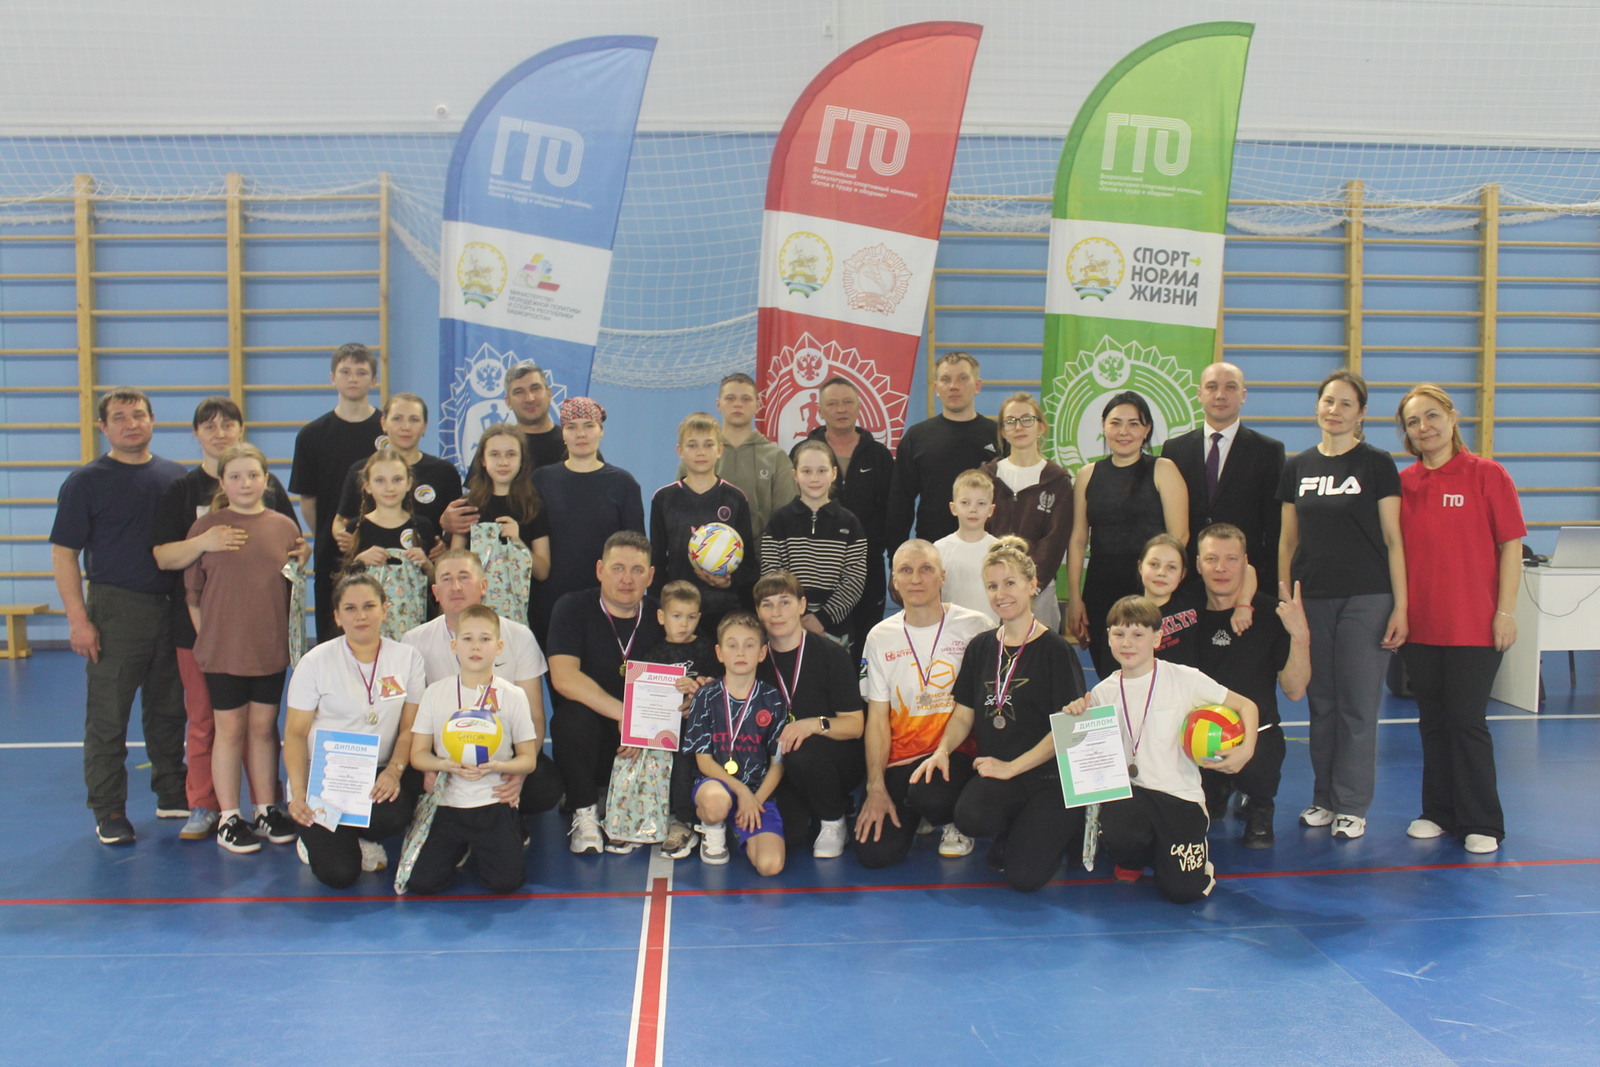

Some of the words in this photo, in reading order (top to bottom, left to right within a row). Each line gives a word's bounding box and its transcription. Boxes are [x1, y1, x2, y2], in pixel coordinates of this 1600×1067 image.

[490, 115, 585, 188] ГТО
[815, 105, 911, 176] ГТО
[1101, 112, 1192, 176] ГТО
[1133, 247, 1190, 267] СПОРТ
[1131, 265, 1200, 288] НОРМА
[1129, 284, 1198, 306] ЖИЗНИ
[1299, 475, 1361, 497] FILA
[1080, 718, 1113, 730] ДИПЛОМ
[333, 743, 368, 753] ДИПЛОМ
